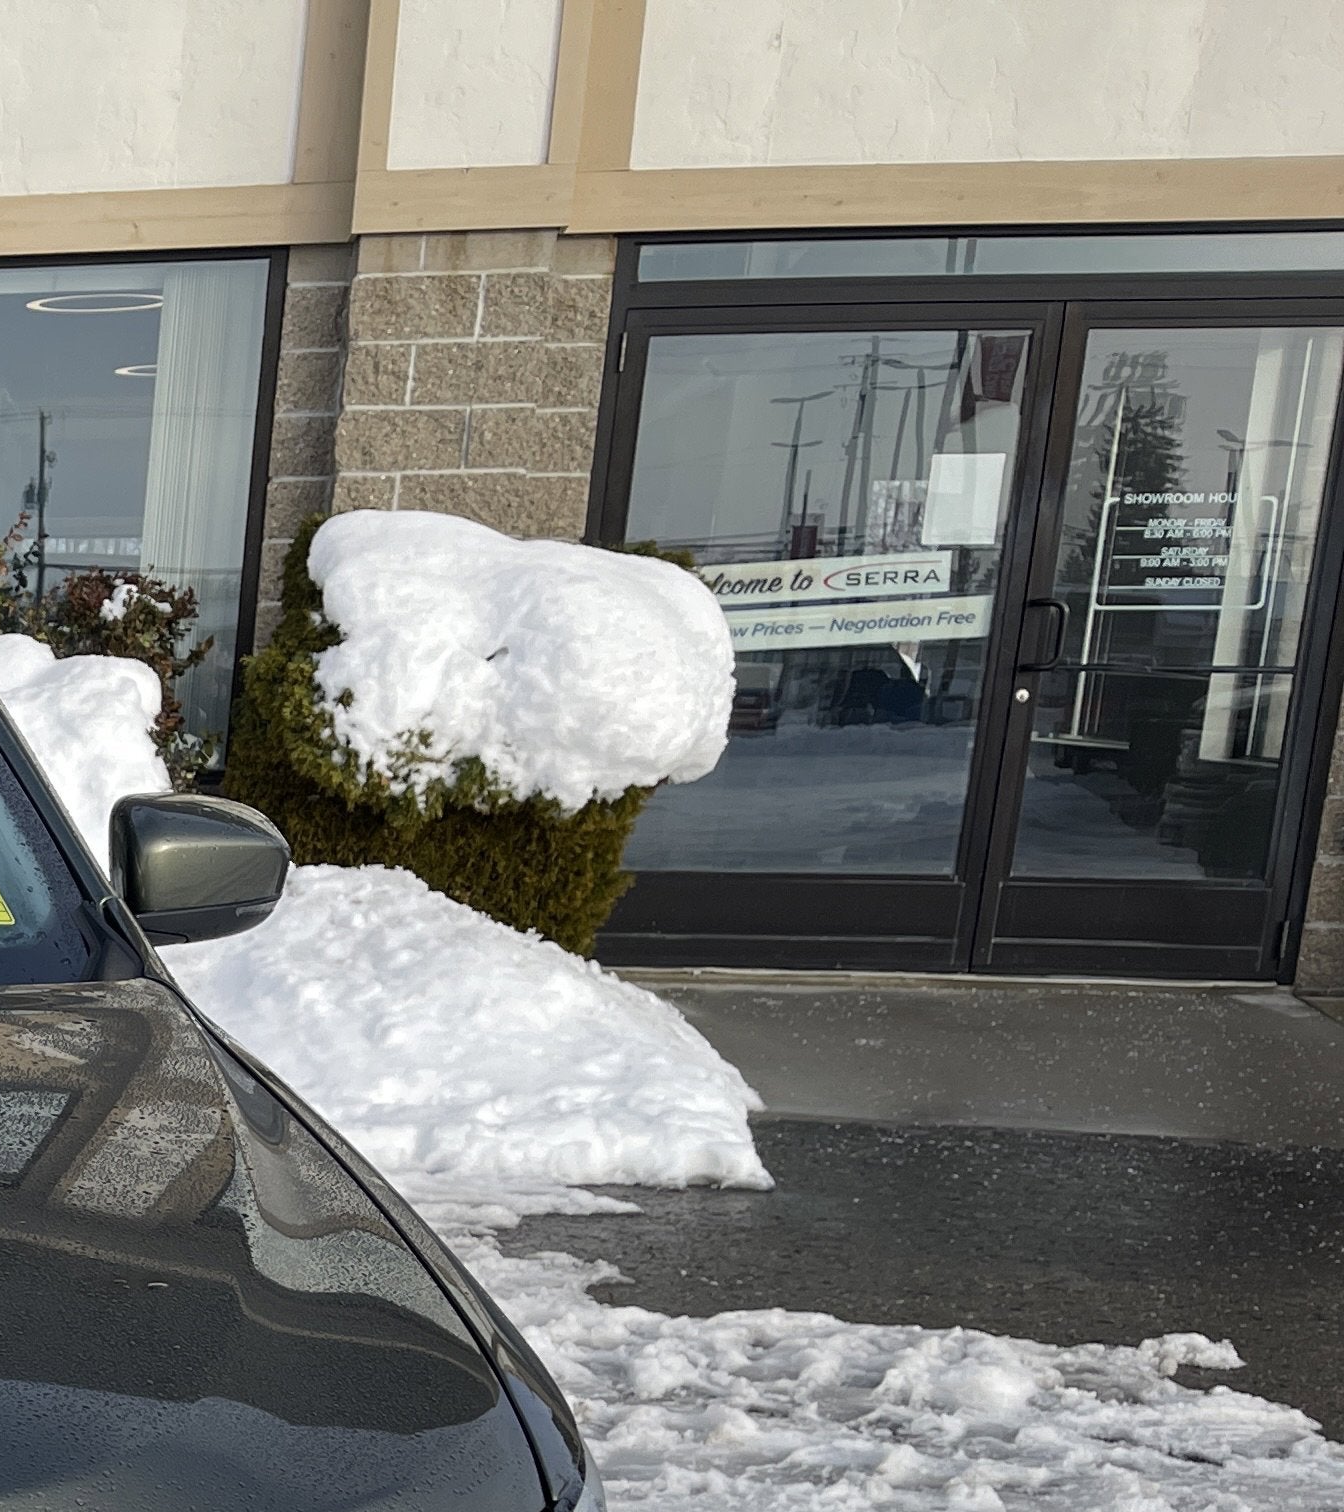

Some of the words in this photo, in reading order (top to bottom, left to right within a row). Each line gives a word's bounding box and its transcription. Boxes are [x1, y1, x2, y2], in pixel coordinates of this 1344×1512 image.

[1123, 492, 1205, 504] SHOWROOM
[1208, 492, 1238, 503] HOU
[1148, 518, 1187, 528] MONDAY
[1194, 518, 1227, 527] FRIDAY
[1166, 529, 1184, 538] AM
[1160, 547, 1209, 557] SATURDAY
[1162, 558, 1180, 567] AM
[1212, 557, 1227, 566] PM
[712, 572, 783, 596] lcome
[790, 569, 814, 592] to
[845, 569, 941, 587] SERRA
[1145, 576, 1182, 587] SUNDAY
[1183, 576, 1220, 587] CLOSED
[751, 621, 804, 637] Prices
[829, 613, 932, 634] Negotiation
[936, 611, 976, 626] Free
